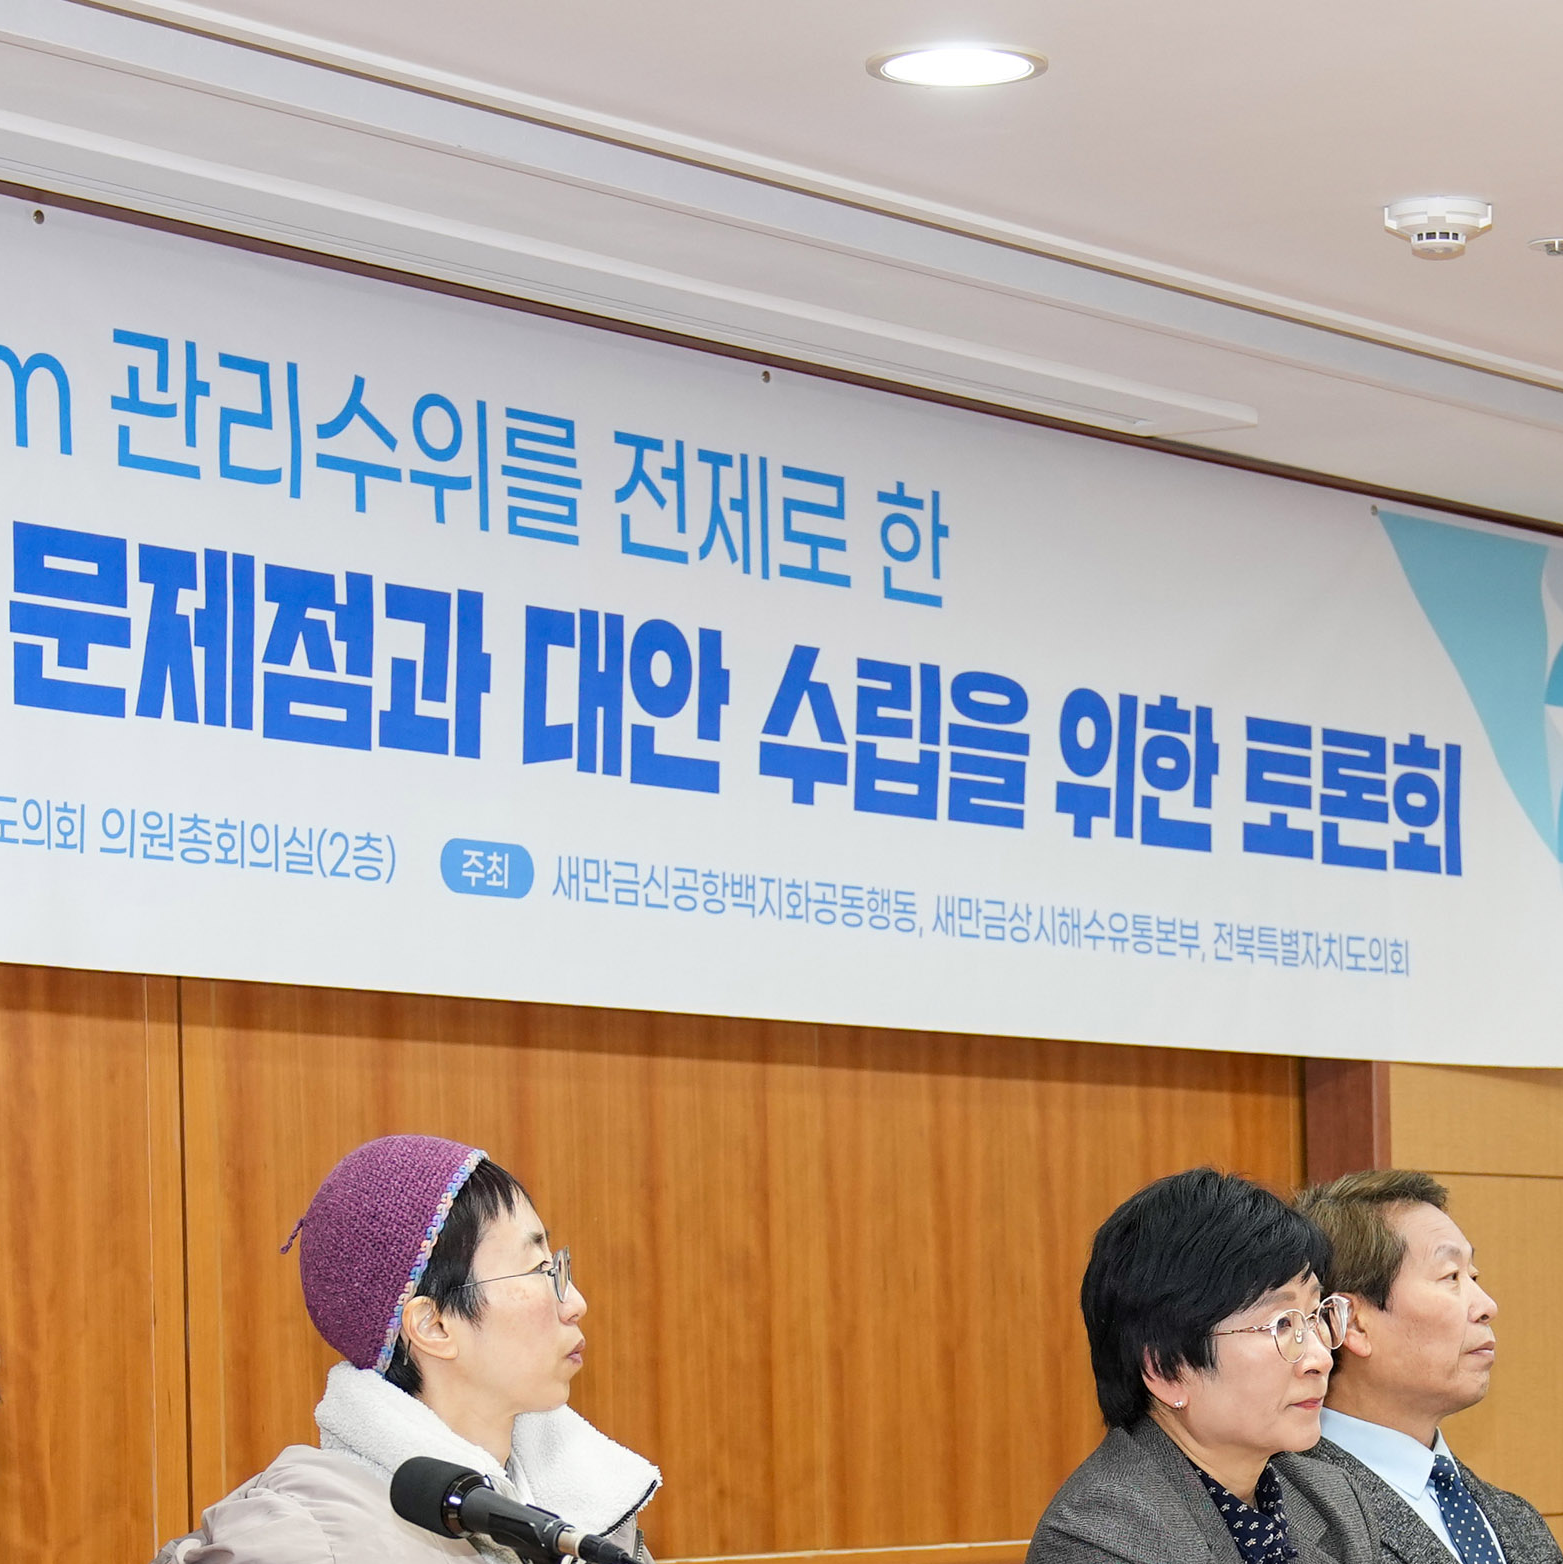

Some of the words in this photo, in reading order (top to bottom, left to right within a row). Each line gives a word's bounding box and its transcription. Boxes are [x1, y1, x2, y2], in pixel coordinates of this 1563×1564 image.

[110, 328, 583, 547] 관리수위를
[613, 430, 852, 589] 전제로
[876, 481, 950, 609] 한
[8, 520, 492, 760] 문제점과
[522, 605, 731, 795] 대안
[758, 644, 1031, 830] 수립을
[1055, 687, 1220, 853] 위한
[1242, 716, 1463, 877] 토론회
[98, 808, 397, 884] 의원총회의실(2층)
[461, 848, 510, 890] 주최
[551, 856, 924, 938] 새만금신공항백지화공동행동,
[932, 894, 1207, 963] 새만금상시해수유통본부,
[1212, 921, 1411, 977] 전북특별자치도의회
